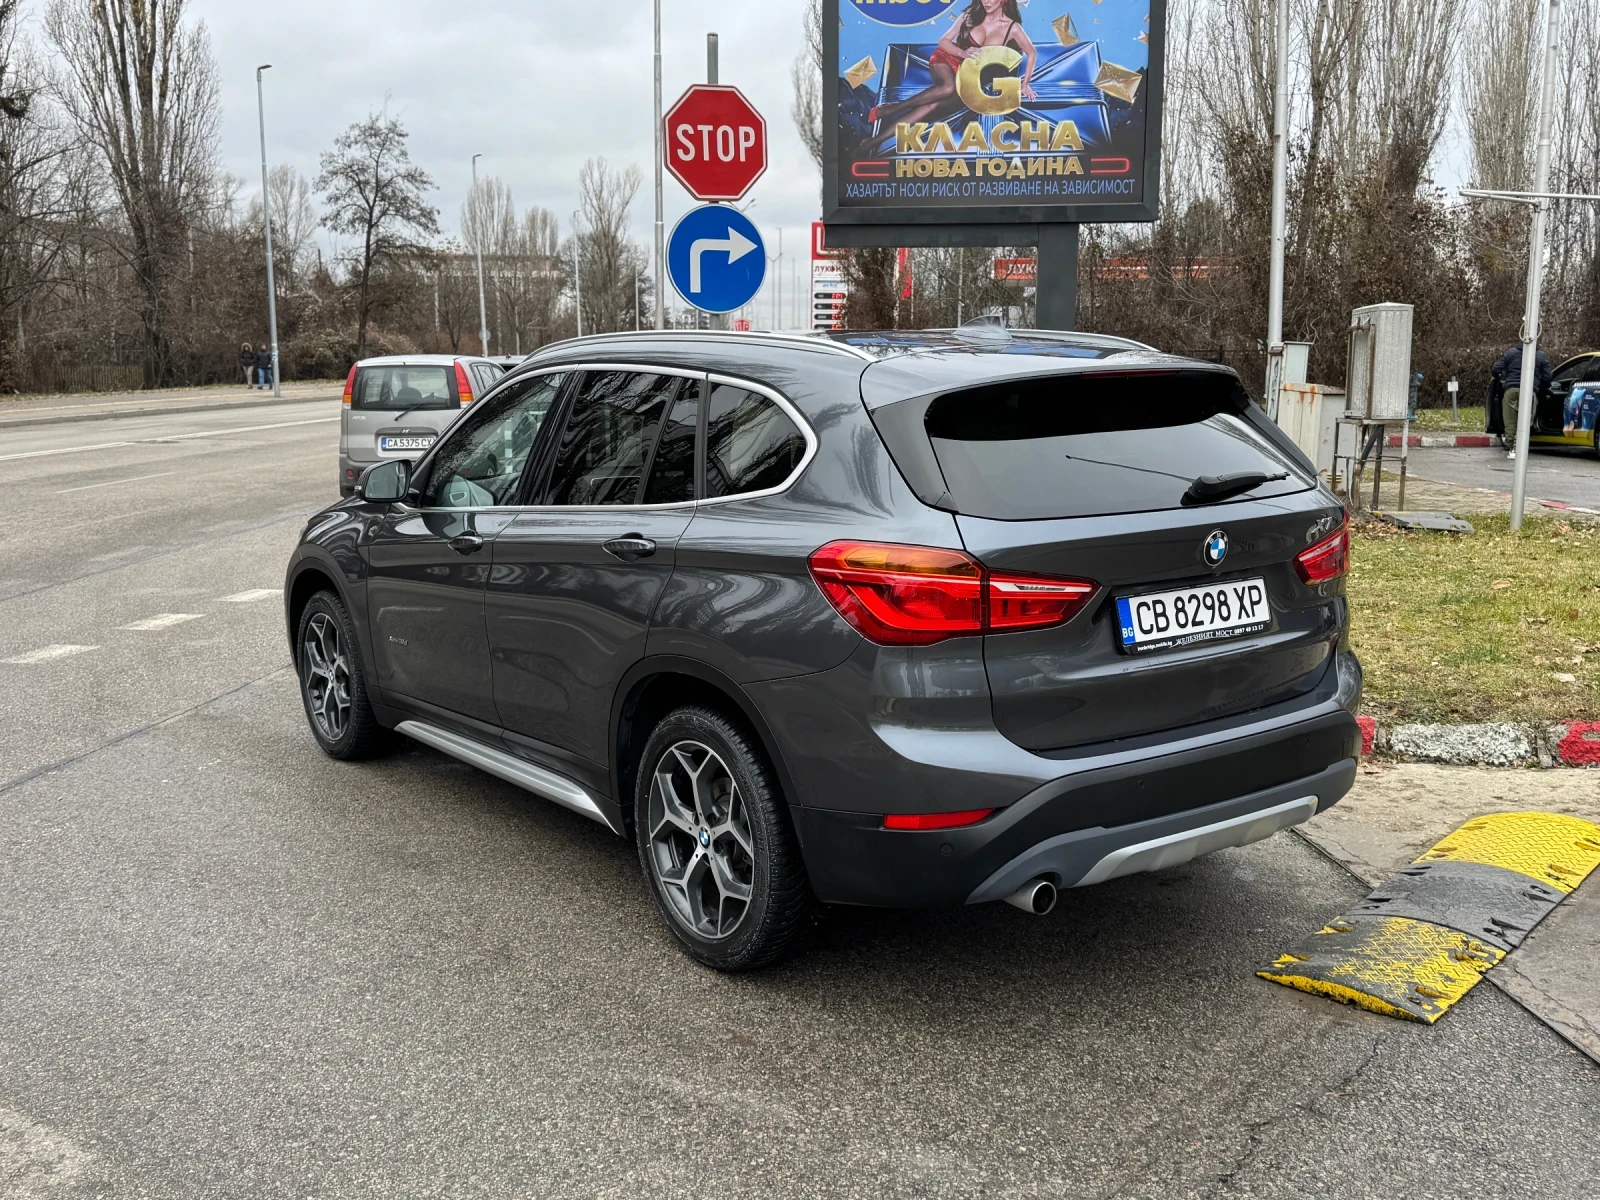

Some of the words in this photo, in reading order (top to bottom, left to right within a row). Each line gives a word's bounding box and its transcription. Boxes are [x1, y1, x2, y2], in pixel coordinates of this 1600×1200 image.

[676, 123, 756, 162] STOP
[895, 121, 1084, 154] КЛАСНА
[895, 158, 970, 178] НОВА
[976, 155, 1084, 179] ГОДИНА
[846, 183, 897, 198] ХАЗАРТЪТ
[899, 183, 929, 197] НОСИ
[932, 182, 960, 197] РИСК
[962, 182, 977, 196] ОТ
[979, 181, 1041, 196] РАЗВИВАНЕ
[1044, 181, 1060, 195] НА
[1062, 179, 1135, 195] ЗАВИСИМОСТ
[400, 438, 420, 447] 5375
[1136, 600, 1170, 635] CB
[1174, 589, 1232, 629] 8298
[1233, 584, 1263, 620] XP
[1122, 627, 1134, 638] BG
[1175, 631, 1214, 645] ЖЕЛЕЗНИЯТ
[1215, 629, 1232, 638] МОСТ
